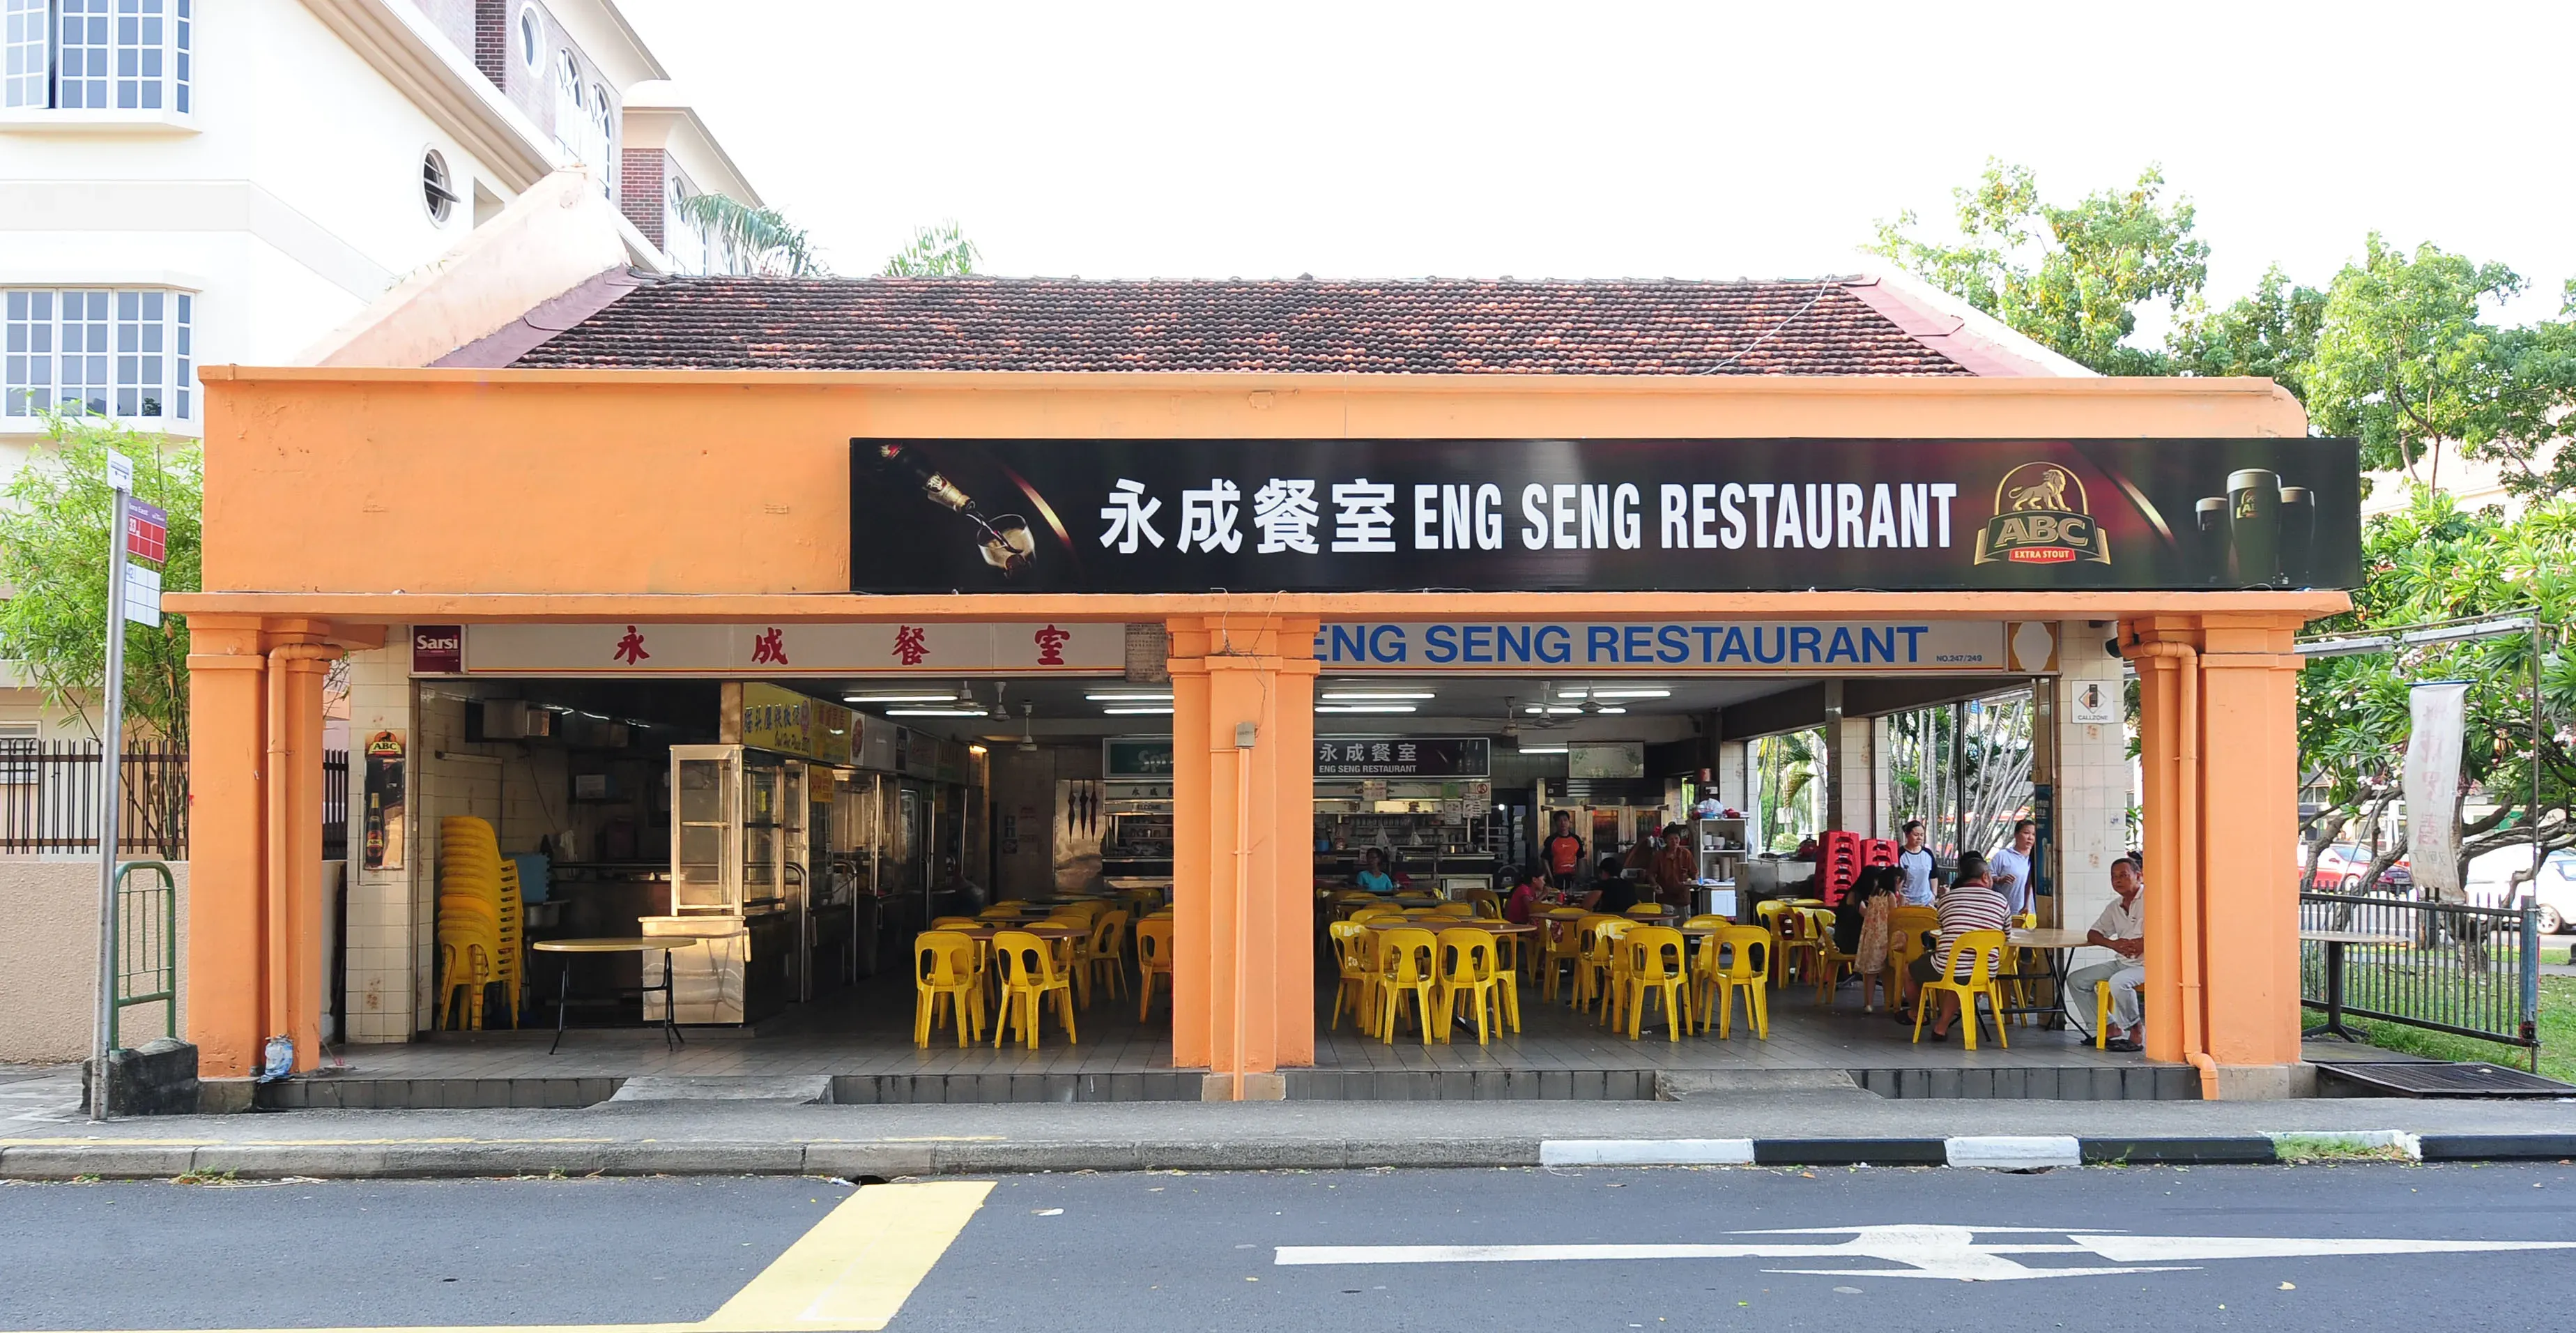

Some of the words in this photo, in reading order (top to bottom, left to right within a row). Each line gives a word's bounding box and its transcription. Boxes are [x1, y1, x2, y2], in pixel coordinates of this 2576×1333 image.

[129, 518, 137, 533] 33
[1098, 478, 1397, 554] 永成餐室
[1414, 482, 1503, 551] ENG
[1521, 482, 1642, 551] SENG
[1660, 482, 1957, 550] RESTAURANT
[1994, 515, 2089, 547] ABC
[2014, 550, 2041, 558] EXTRA
[2042, 550, 2070, 558] STOUT
[416, 634, 459, 650] Sarsi
[613, 625, 1071, 666] 永成餐室
[1424, 625, 1571, 664] SENG
[1587, 625, 1929, 665] RESTAURANT
[1319, 743, 1417, 762] 永成餐室
[1319, 765, 1336, 773] ENG
[1337, 765, 1361, 773] SENG
[1362, 765, 1417, 773] RESTAURANT
